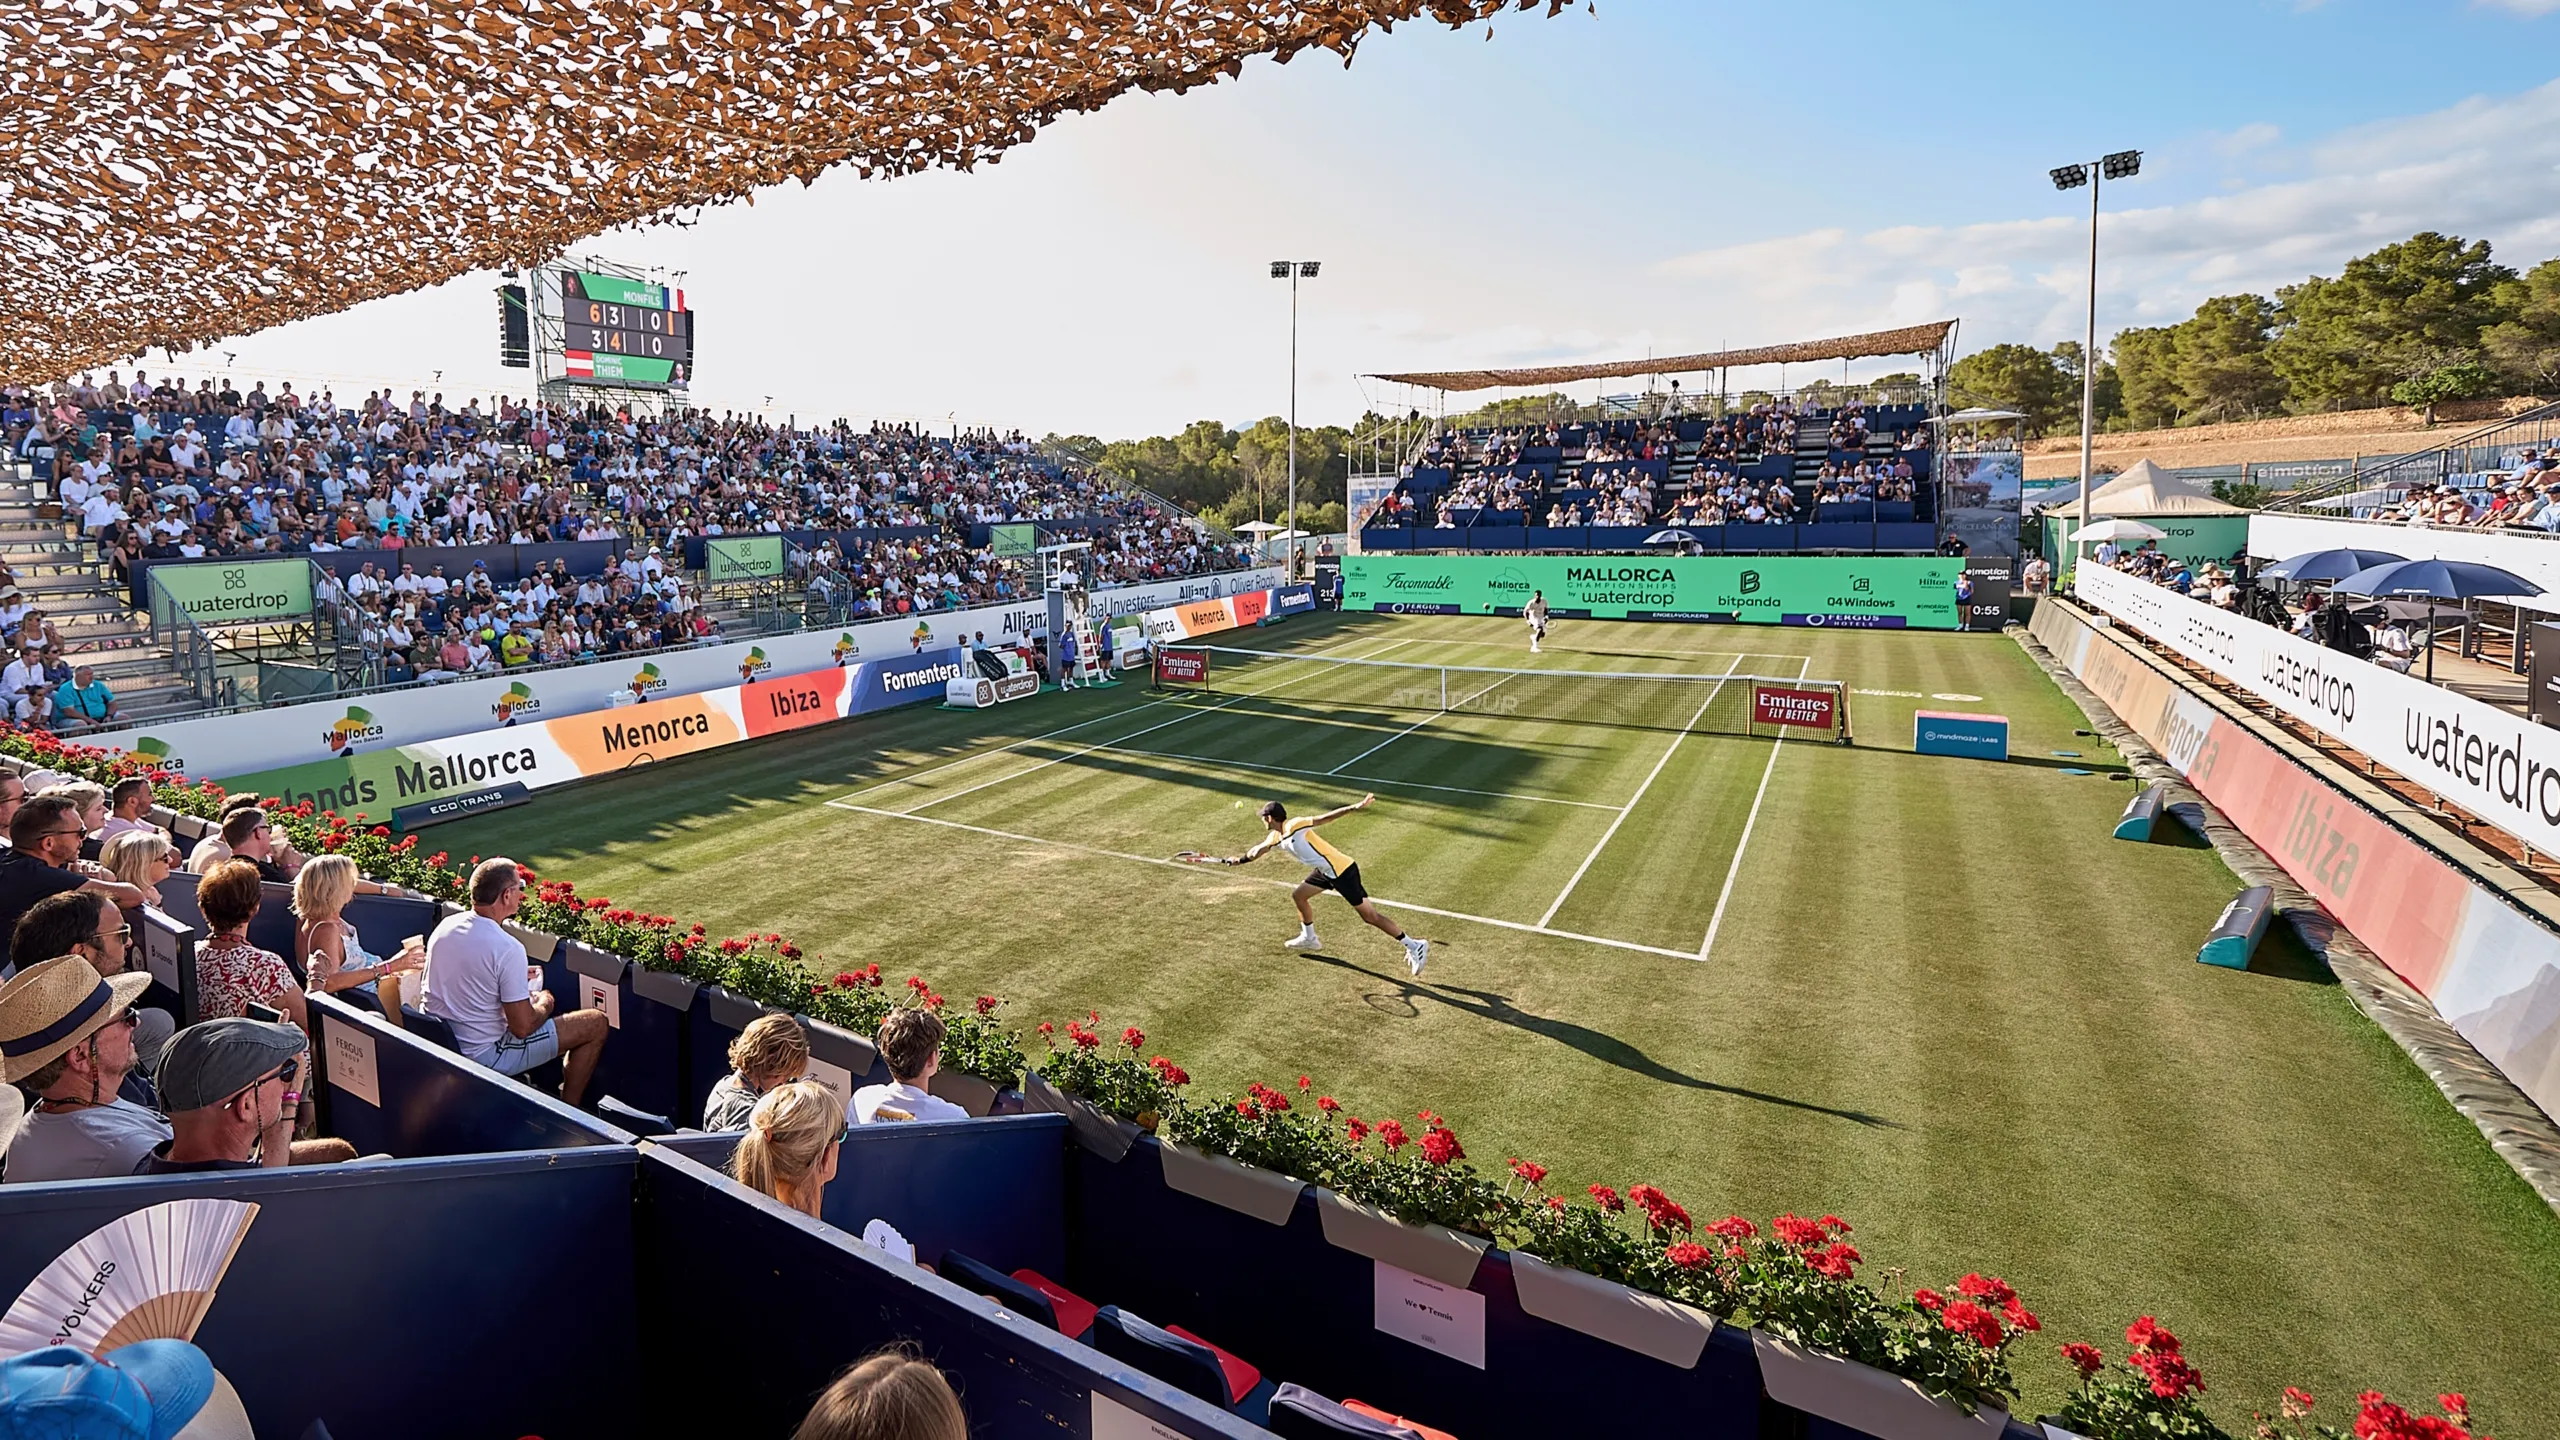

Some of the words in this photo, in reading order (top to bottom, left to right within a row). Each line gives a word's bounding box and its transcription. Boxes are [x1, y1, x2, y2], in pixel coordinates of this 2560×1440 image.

[623, 290, 661, 306] MONFILS
[589, 303, 600, 323] 6
[609, 306, 619, 325] 3
[651, 312, 661, 331] 0
[591, 330, 601, 349] 3
[610, 332, 620, 351] 4
[652, 337, 662, 355] 0
[596, 355, 622, 365] DOMINIC
[596, 365, 623, 377] THIEM
[1382, 572, 1454, 590] Façonnable
[1567, 568, 1675, 582] MALLORCA
[1180, 584, 1209, 599] Allianz
[1230, 577, 1254, 594] Oliver
[1488, 580, 1530, 590] Mallorca
[1567, 582, 1676, 590] CHAMPIONSHIPS
[182, 592, 288, 614] waterdrop
[1110, 595, 1155, 615] Investors
[1280, 592, 1309, 608] Formentera
[1582, 591, 1675, 607] waterdrop
[1718, 596, 1781, 608] bitpanda
[1844, 597, 1895, 608] Windows
[1192, 609, 1225, 626] Menorca
[1243, 602, 1260, 616] Ibiza
[1972, 605, 2000, 615] 0:55
[738, 661, 771, 673] Mallorca
[1162, 656, 1201, 669] Emirates
[627, 678, 667, 691] Mallorca
[882, 662, 961, 692] Formentera
[1000, 679, 1034, 694] waterdrop
[2261, 648, 2355, 732] waterdrop
[491, 698, 540, 715] Mallorca
[770, 688, 821, 717] Ibiza
[1759, 693, 1829, 712] Emirates
[1768, 707, 1785, 719] FLY
[1785, 709, 1818, 722] BETTER
[322, 724, 383, 744] Mallorca
[602, 713, 709, 753] Menorca
[1937, 733, 1978, 742] mindmaze
[2155, 694, 2220, 781] Menorca
[2406, 707, 2560, 826] waterdro
[283, 775, 377, 814] lands
[395, 748, 537, 797] Mallorca
[430, 802, 458, 814] ECO
[460, 792, 502, 808] TRANS
[2282, 790, 2360, 899] Ibiza
[335, 1037, 364, 1058] FERGUS
[340, 1051, 360, 1063] GROUP
[1404, 1298, 1418, 1308] We
[1427, 1306, 1453, 1321] Tennis
